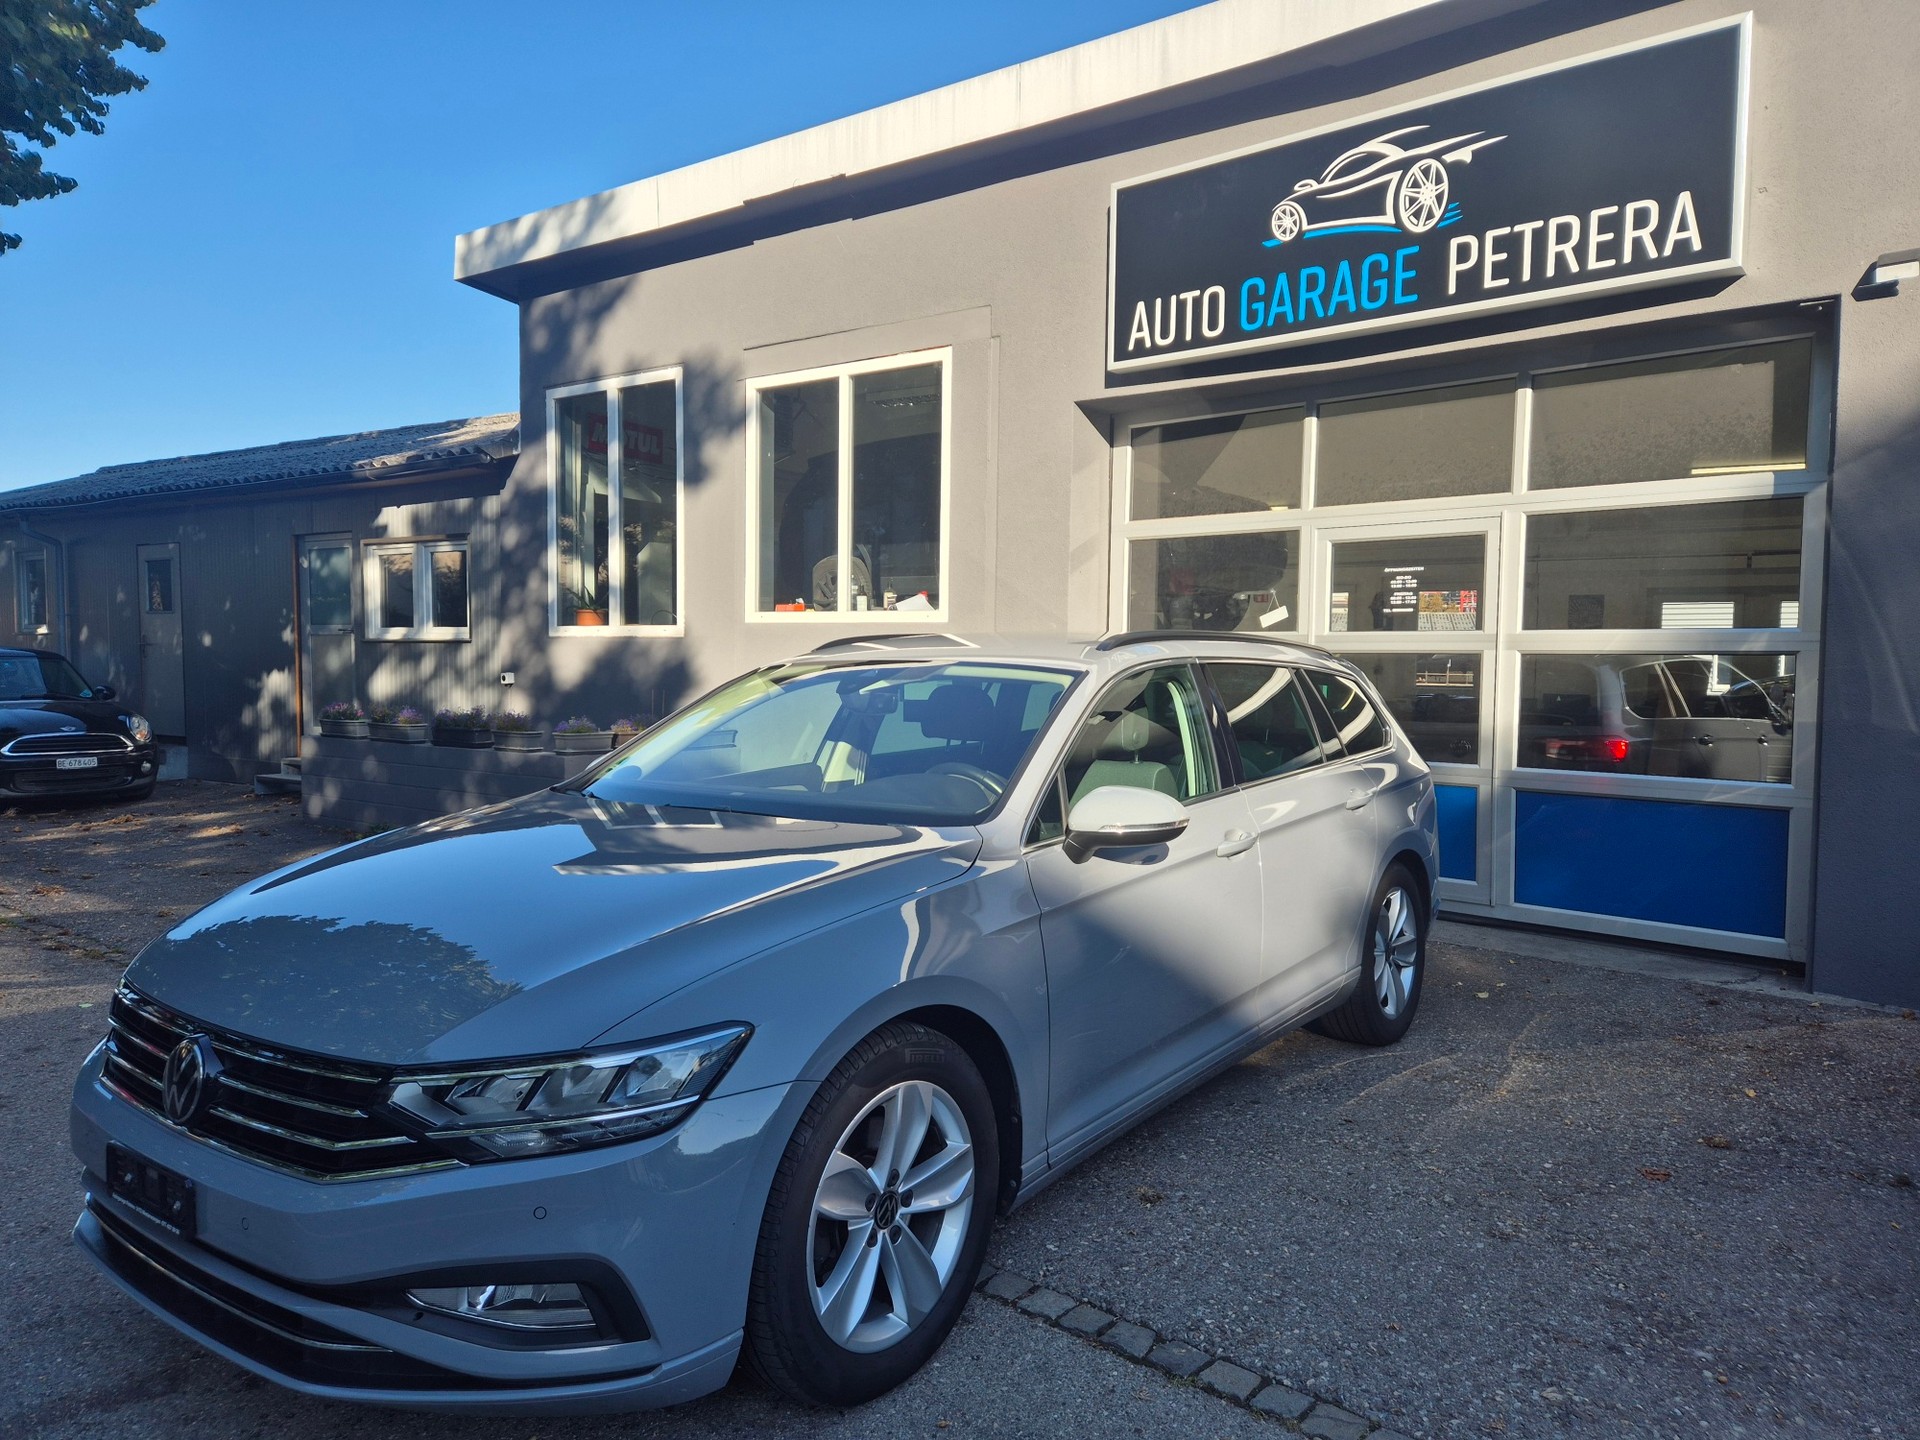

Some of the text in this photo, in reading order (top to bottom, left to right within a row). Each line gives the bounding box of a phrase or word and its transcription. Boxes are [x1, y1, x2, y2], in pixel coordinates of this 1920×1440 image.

[1127, 190, 1704, 351] AUTO GARAGE PETRERA
[591, 422, 661, 455] MTUL
[904, 1047, 945, 1064] PIRELLI
